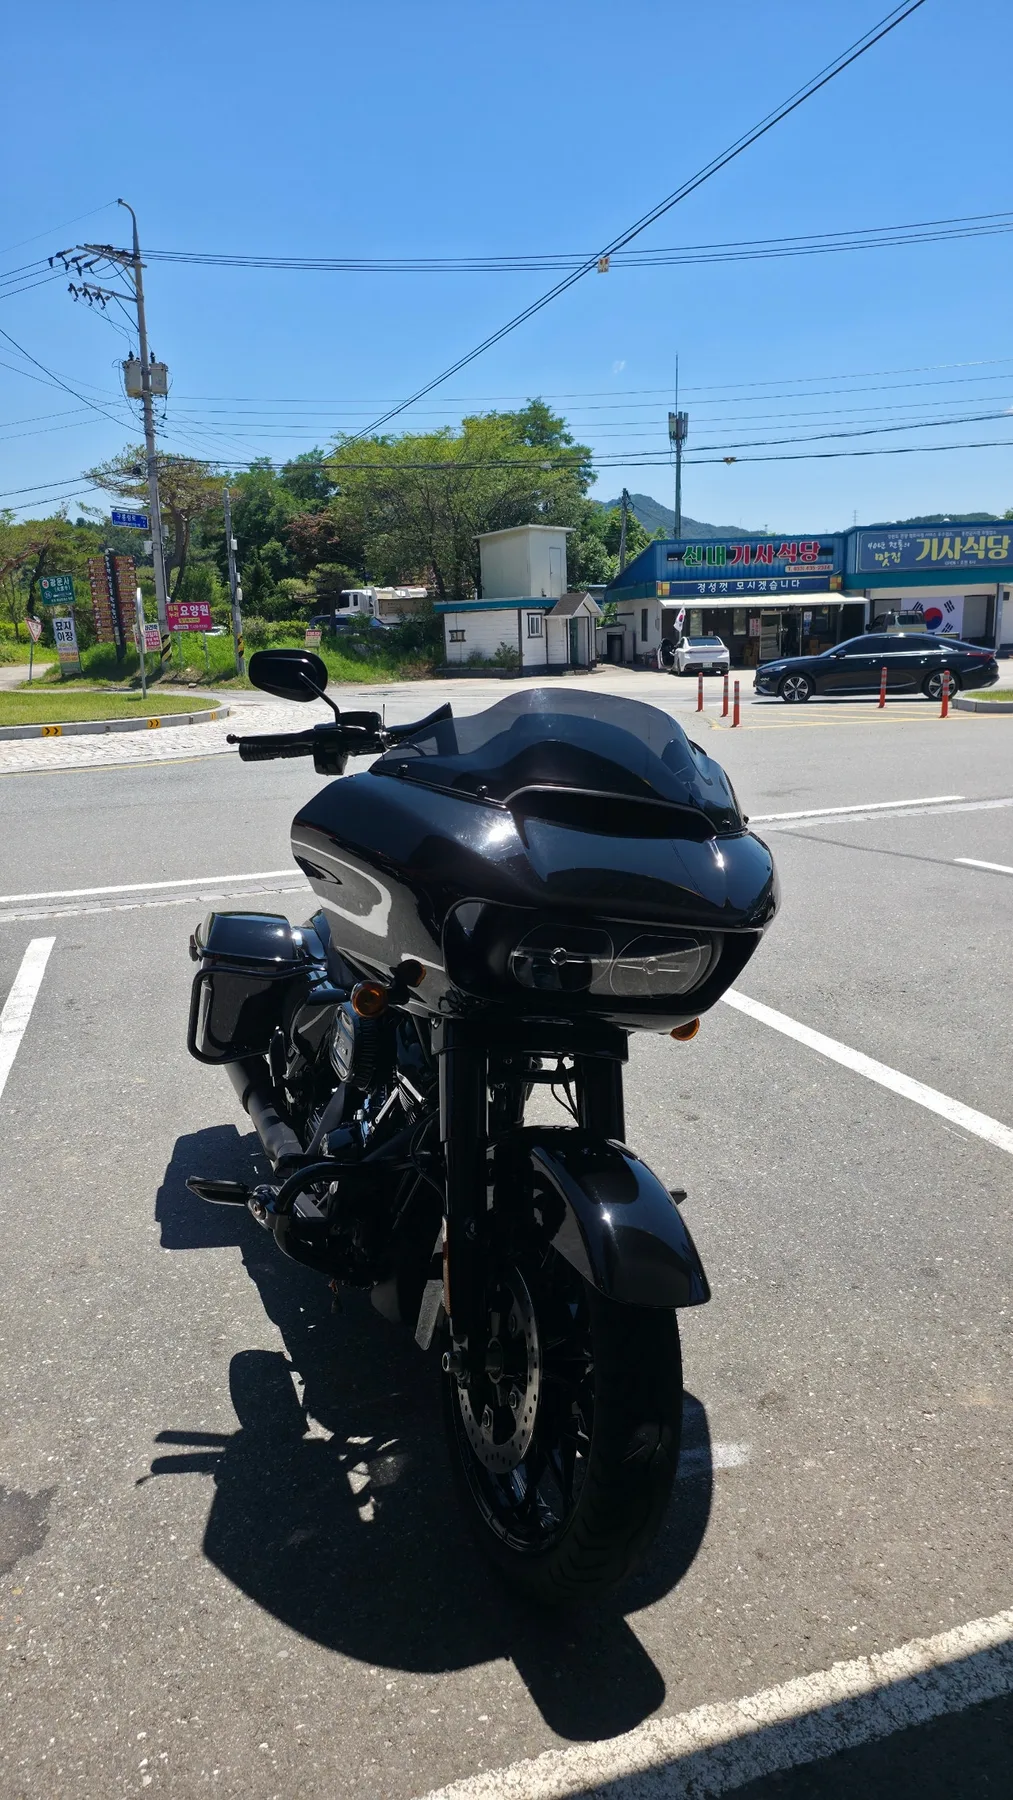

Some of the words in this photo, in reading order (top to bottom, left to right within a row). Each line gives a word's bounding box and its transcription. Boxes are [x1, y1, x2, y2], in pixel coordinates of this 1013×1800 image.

[681, 541, 821, 567] 신내기사식당
[915, 535, 1011, 561] 기사식당
[874, 551, 901, 567] 맛집
[697, 582, 728, 594] 정성껏
[736, 579, 801, 591] 모시겠습니다
[180, 604, 209, 617] 요양원
[55, 621, 72, 631] 묘지
[57, 631, 74, 642] 이장
